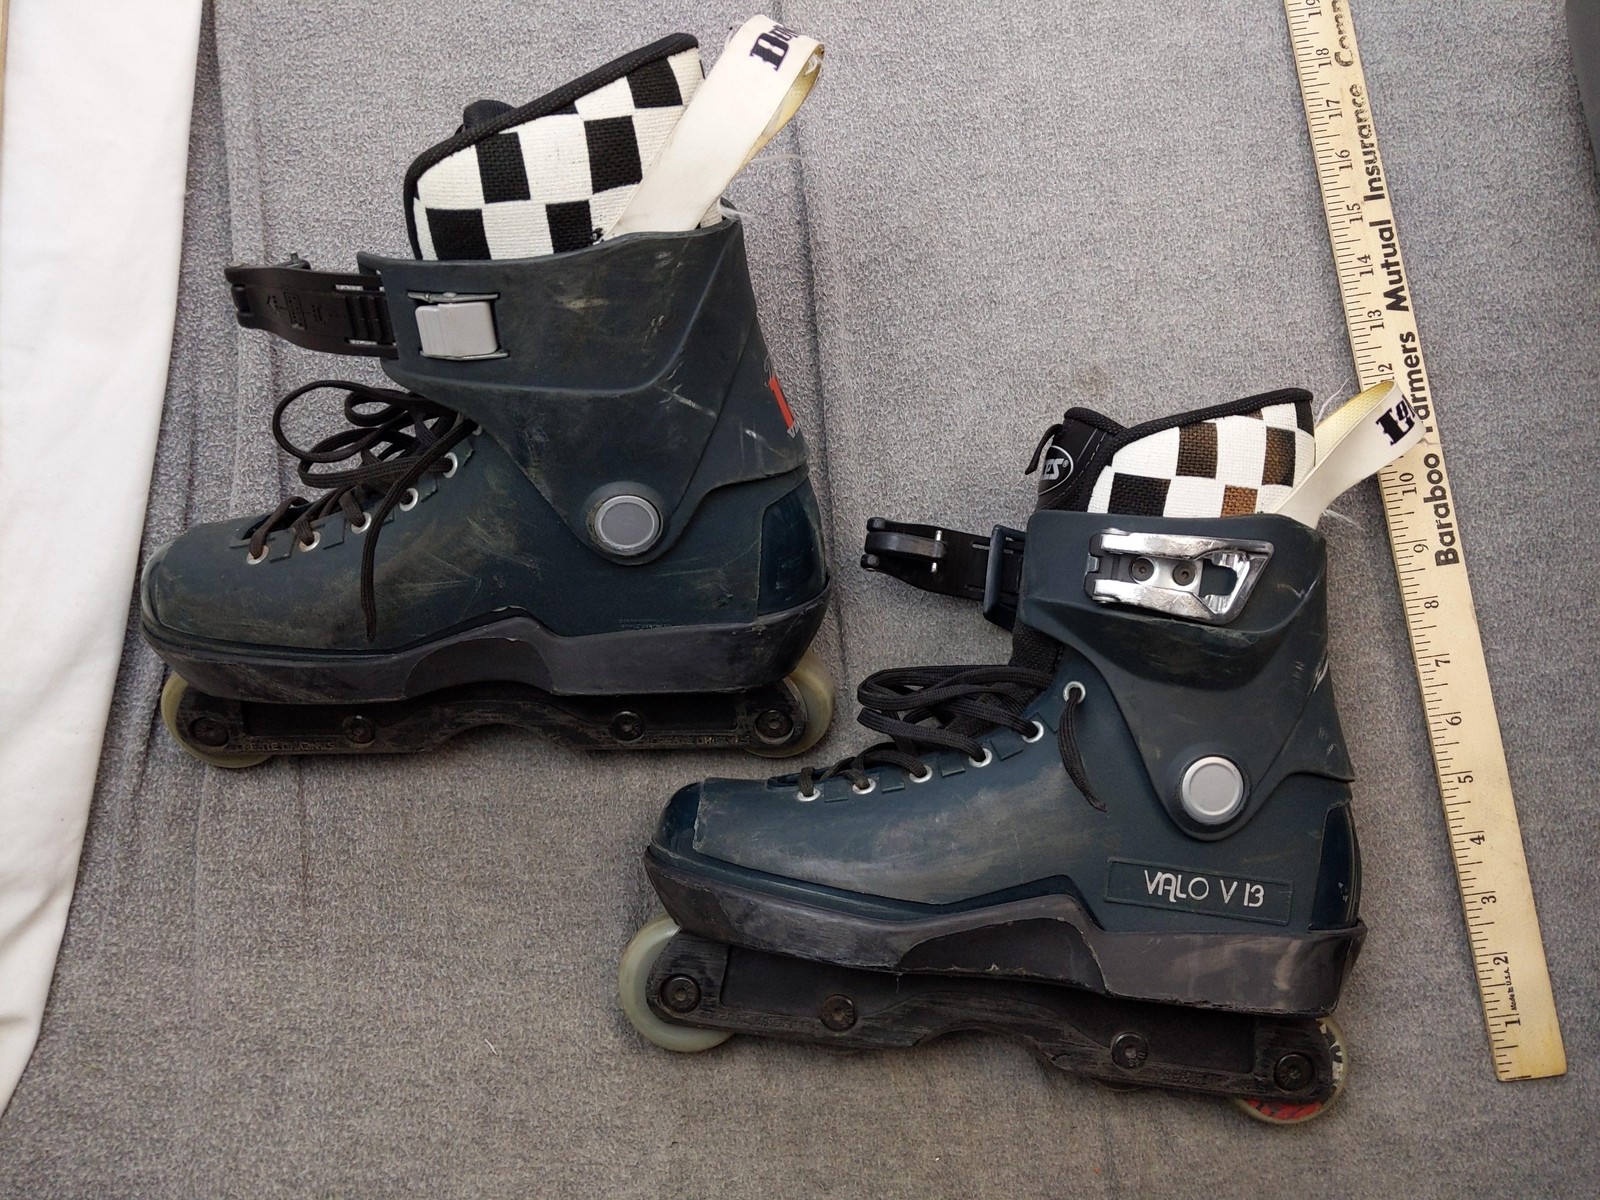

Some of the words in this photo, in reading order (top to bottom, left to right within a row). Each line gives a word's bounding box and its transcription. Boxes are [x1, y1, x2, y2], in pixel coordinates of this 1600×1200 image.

[1315, 47, 1332, 69] 18
[1325, 98, 1343, 120] 17
[1350, 83, 1386, 202] Insurance
[1334, 149, 1354, 171] 16
[1346, 202, 1364, 224] 15
[1357, 253, 1375, 277] 14
[1369, 219, 1410, 312] Mutual
[1367, 309, 1385, 331] 13
[1400, 330, 1434, 434] armers
[1399, 472, 1418, 497] 10
[1423, 452, 1460, 567] Baraboo
[1413, 543, 1429, 554] 9
[1424, 599, 1440, 610] 8
[1435, 658, 1451, 668] 7
[1446, 715, 1463, 726] 6
[1458, 774, 1474, 784] 5
[1469, 834, 1486, 846] 4
[1144, 869, 1210, 903] VALO
[1219, 879, 1239, 904] V
[1243, 882, 1265, 908] 13
[1480, 895, 1497, 905] 3
[1493, 955, 1509, 965] 2
[1504, 1017, 1521, 1028] 1
